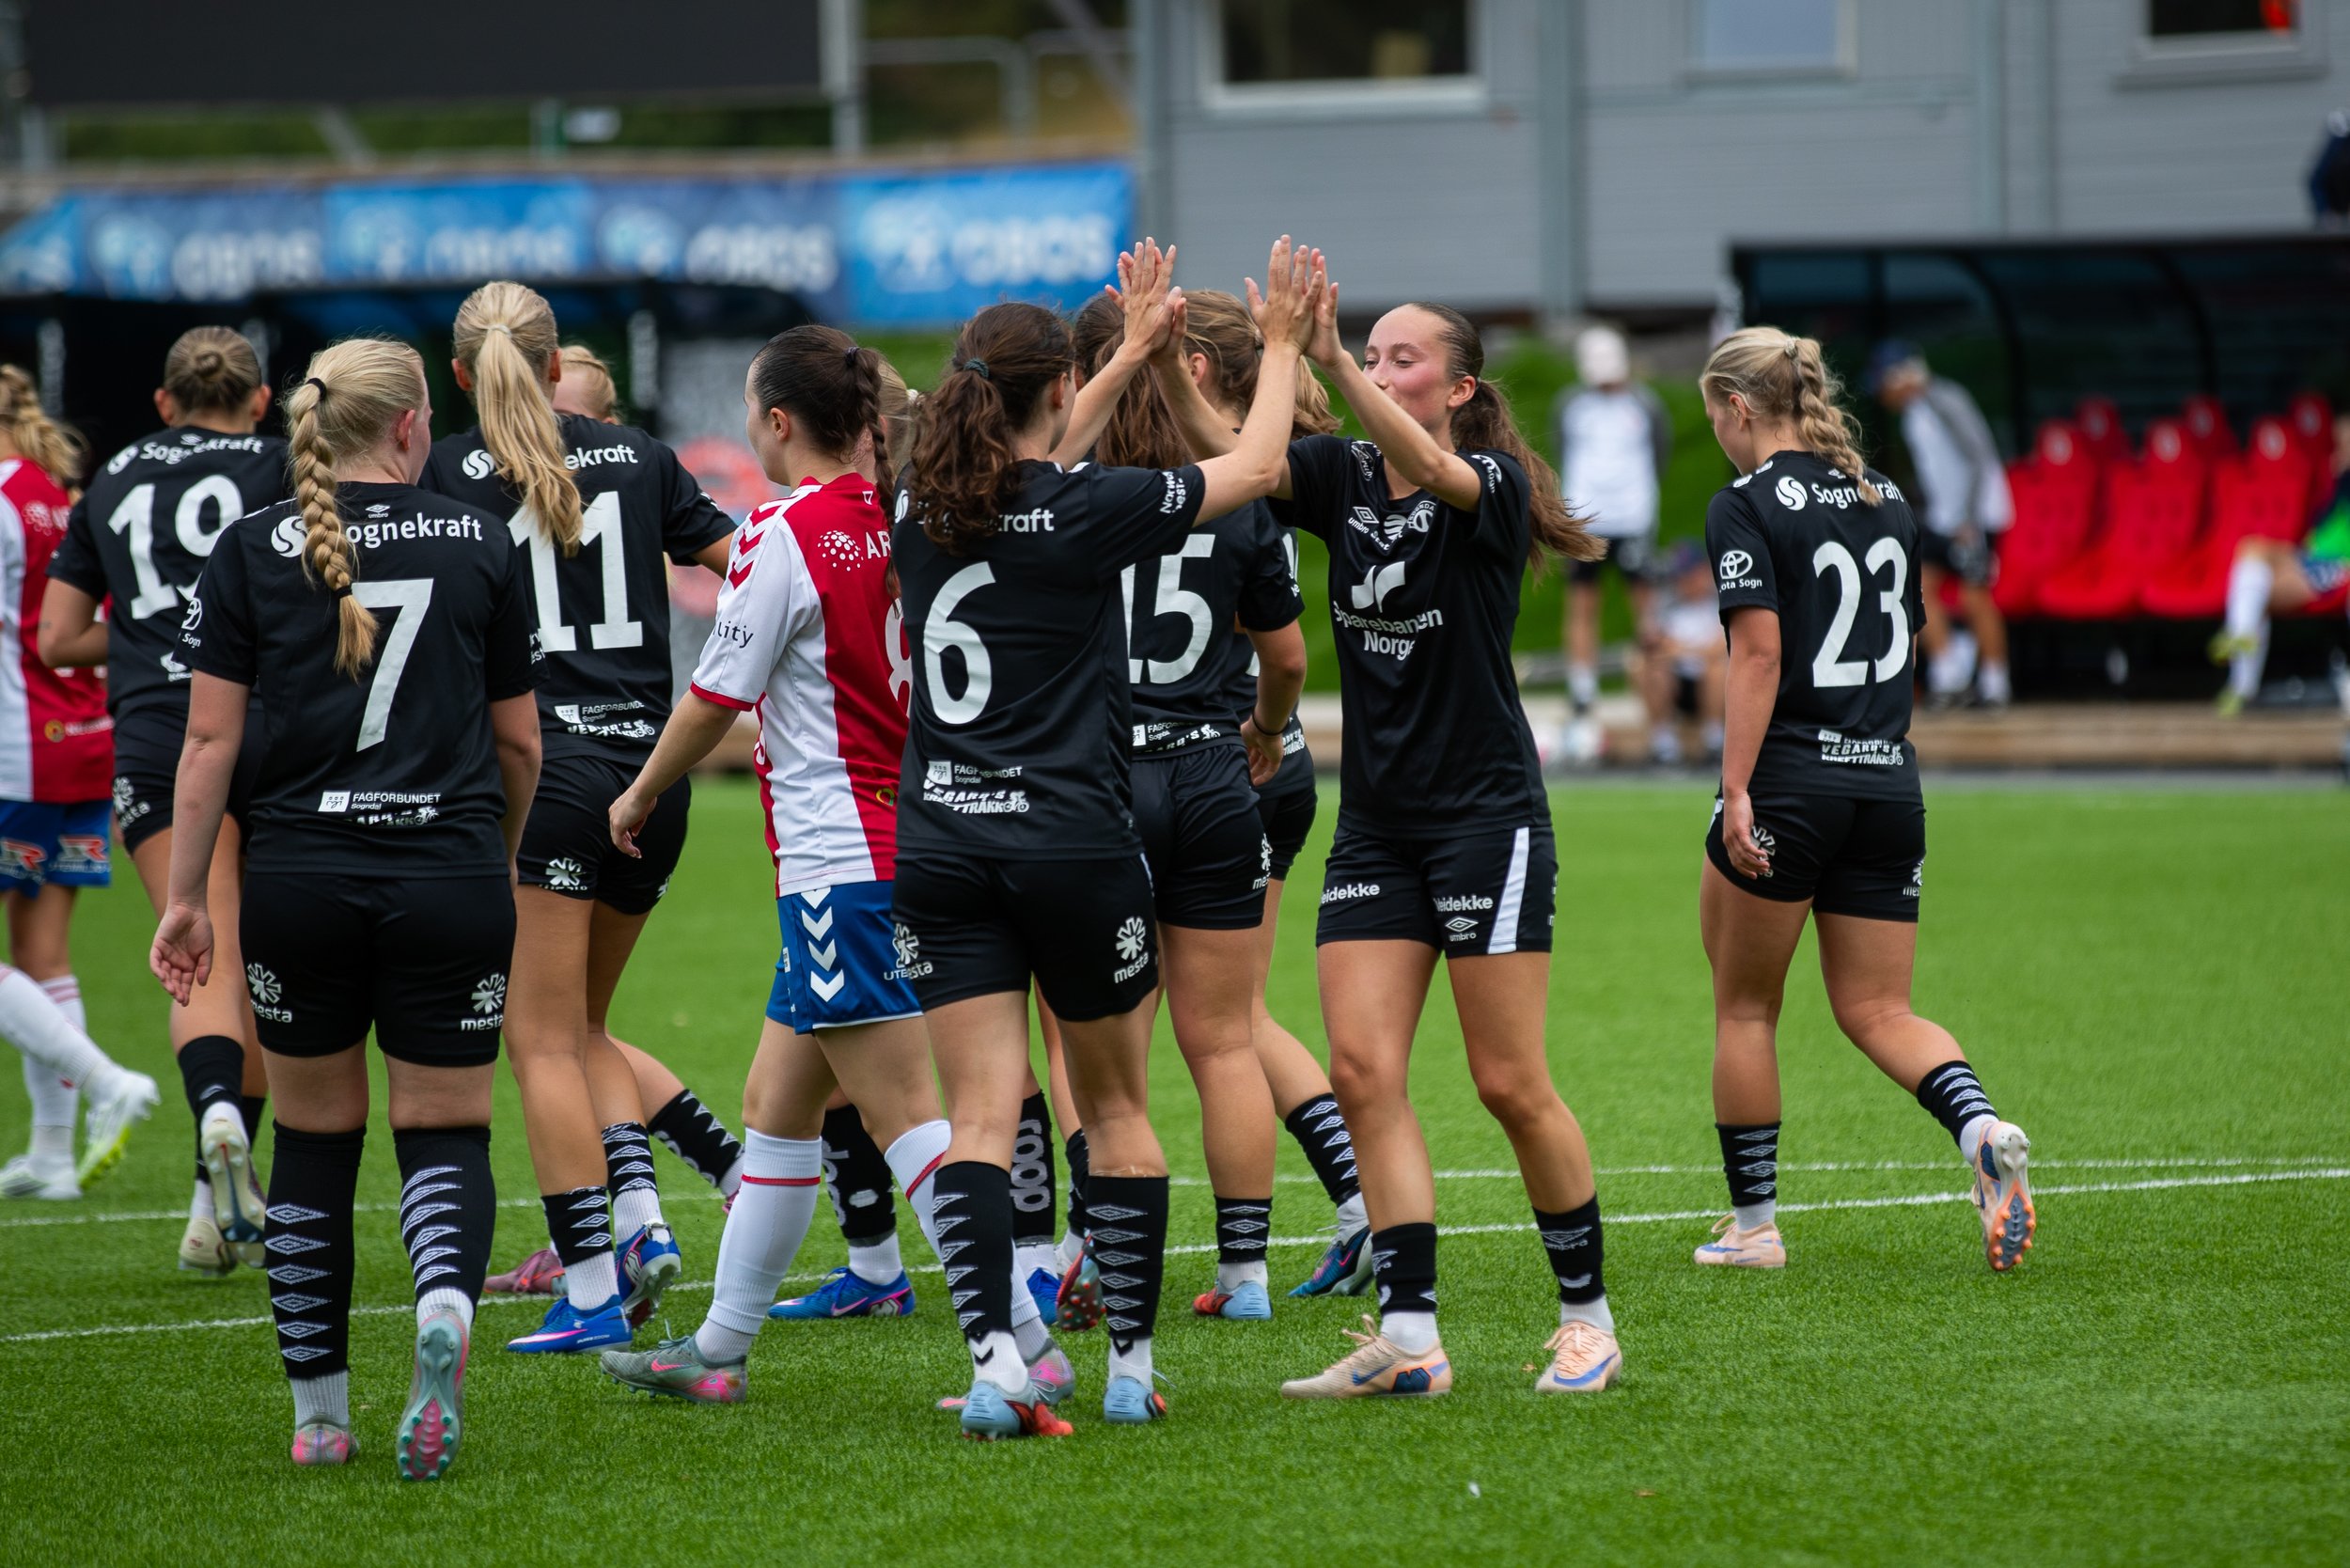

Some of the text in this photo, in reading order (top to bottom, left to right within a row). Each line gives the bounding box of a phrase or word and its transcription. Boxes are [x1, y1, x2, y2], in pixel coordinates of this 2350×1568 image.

[564, 444, 638, 470] ekraft
[345, 512, 483, 549] ognekraft
[1347, 516, 1371, 535] umbro
[107, 474, 244, 620] 19
[507, 491, 643, 652] 11
[1738, 577, 1763, 589] Sogn
[1812, 536, 1910, 688] 23
[181, 633, 202, 649] Sogn
[923, 561, 996, 724] 6
[352, 577, 433, 752] 7
[582, 700, 645, 715] FAGFORBUND
[954, 764, 1023, 778] FAGFBNDET
[351, 802, 382, 810] Sogndal
[352, 791, 441, 804] FAGFORBUNDET
[1321, 882, 1381, 904] eidekke
[1449, 932, 1477, 942] umbro
[1114, 951, 1149, 984] mesta
